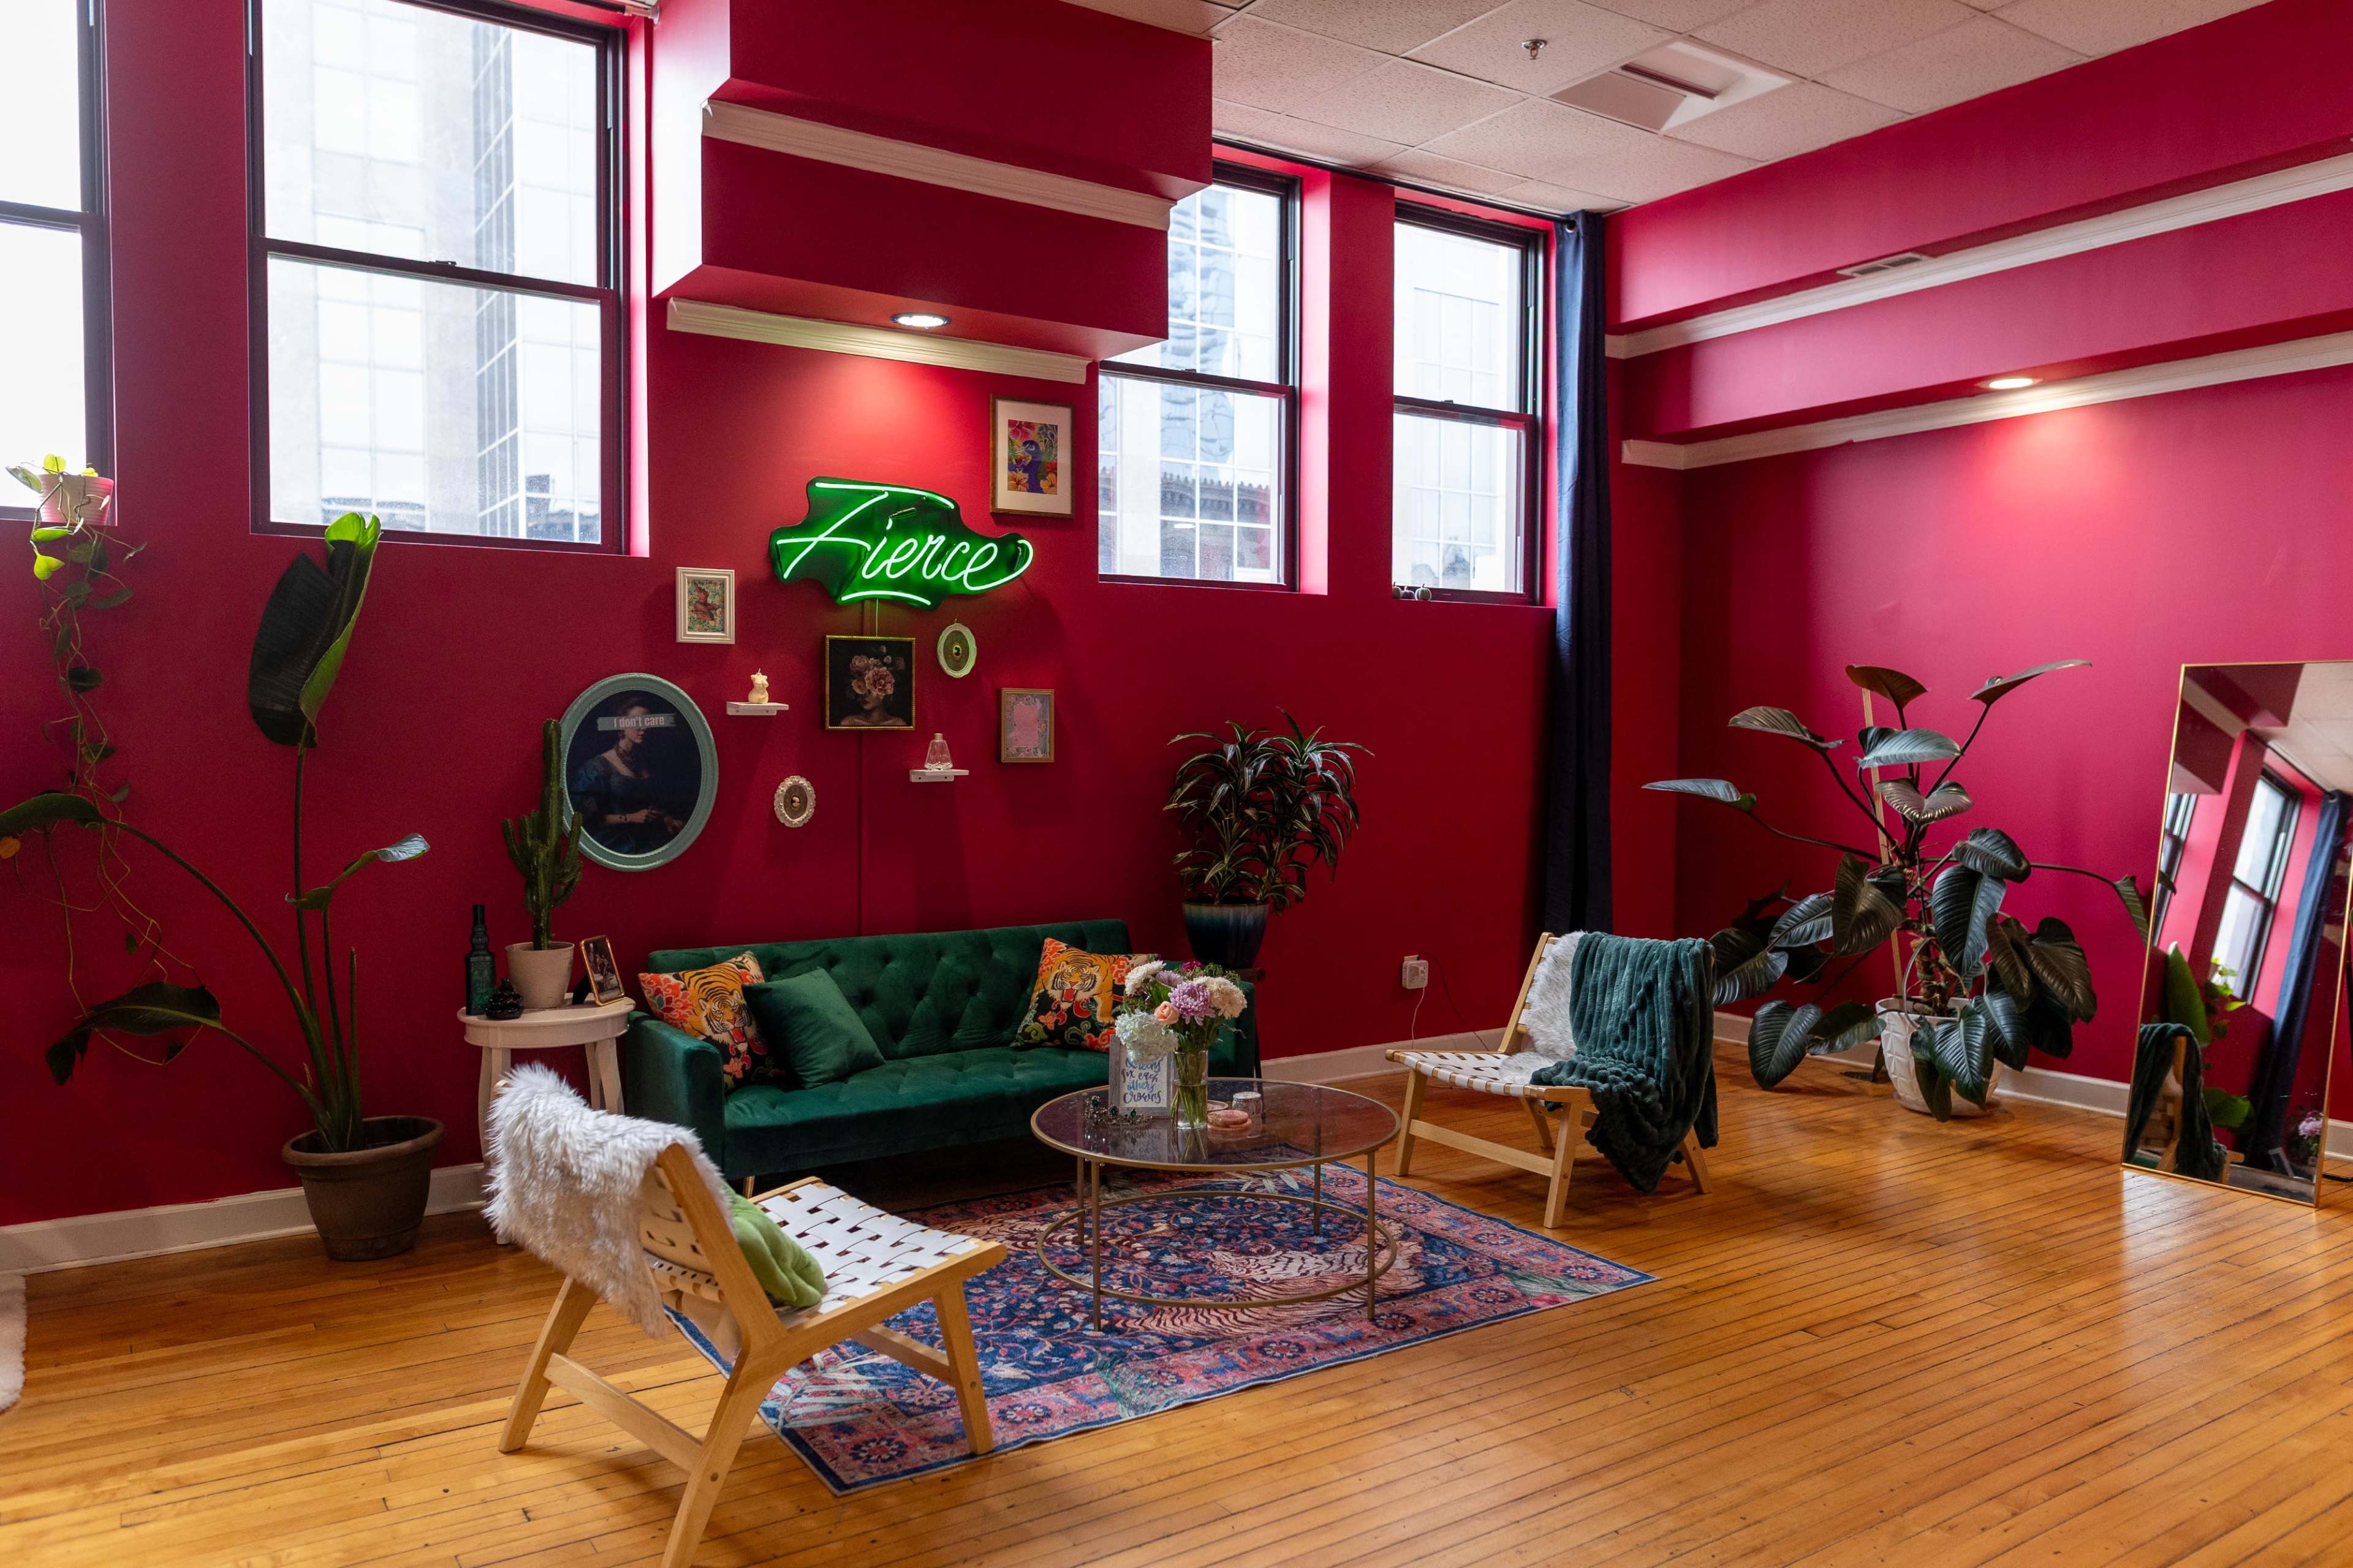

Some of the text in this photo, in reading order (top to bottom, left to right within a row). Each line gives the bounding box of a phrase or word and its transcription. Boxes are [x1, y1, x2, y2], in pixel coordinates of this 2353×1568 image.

[776, 482, 1034, 592] Fierce
[614, 716, 665, 728] I don't care
[1138, 1072, 1158, 1083] each
